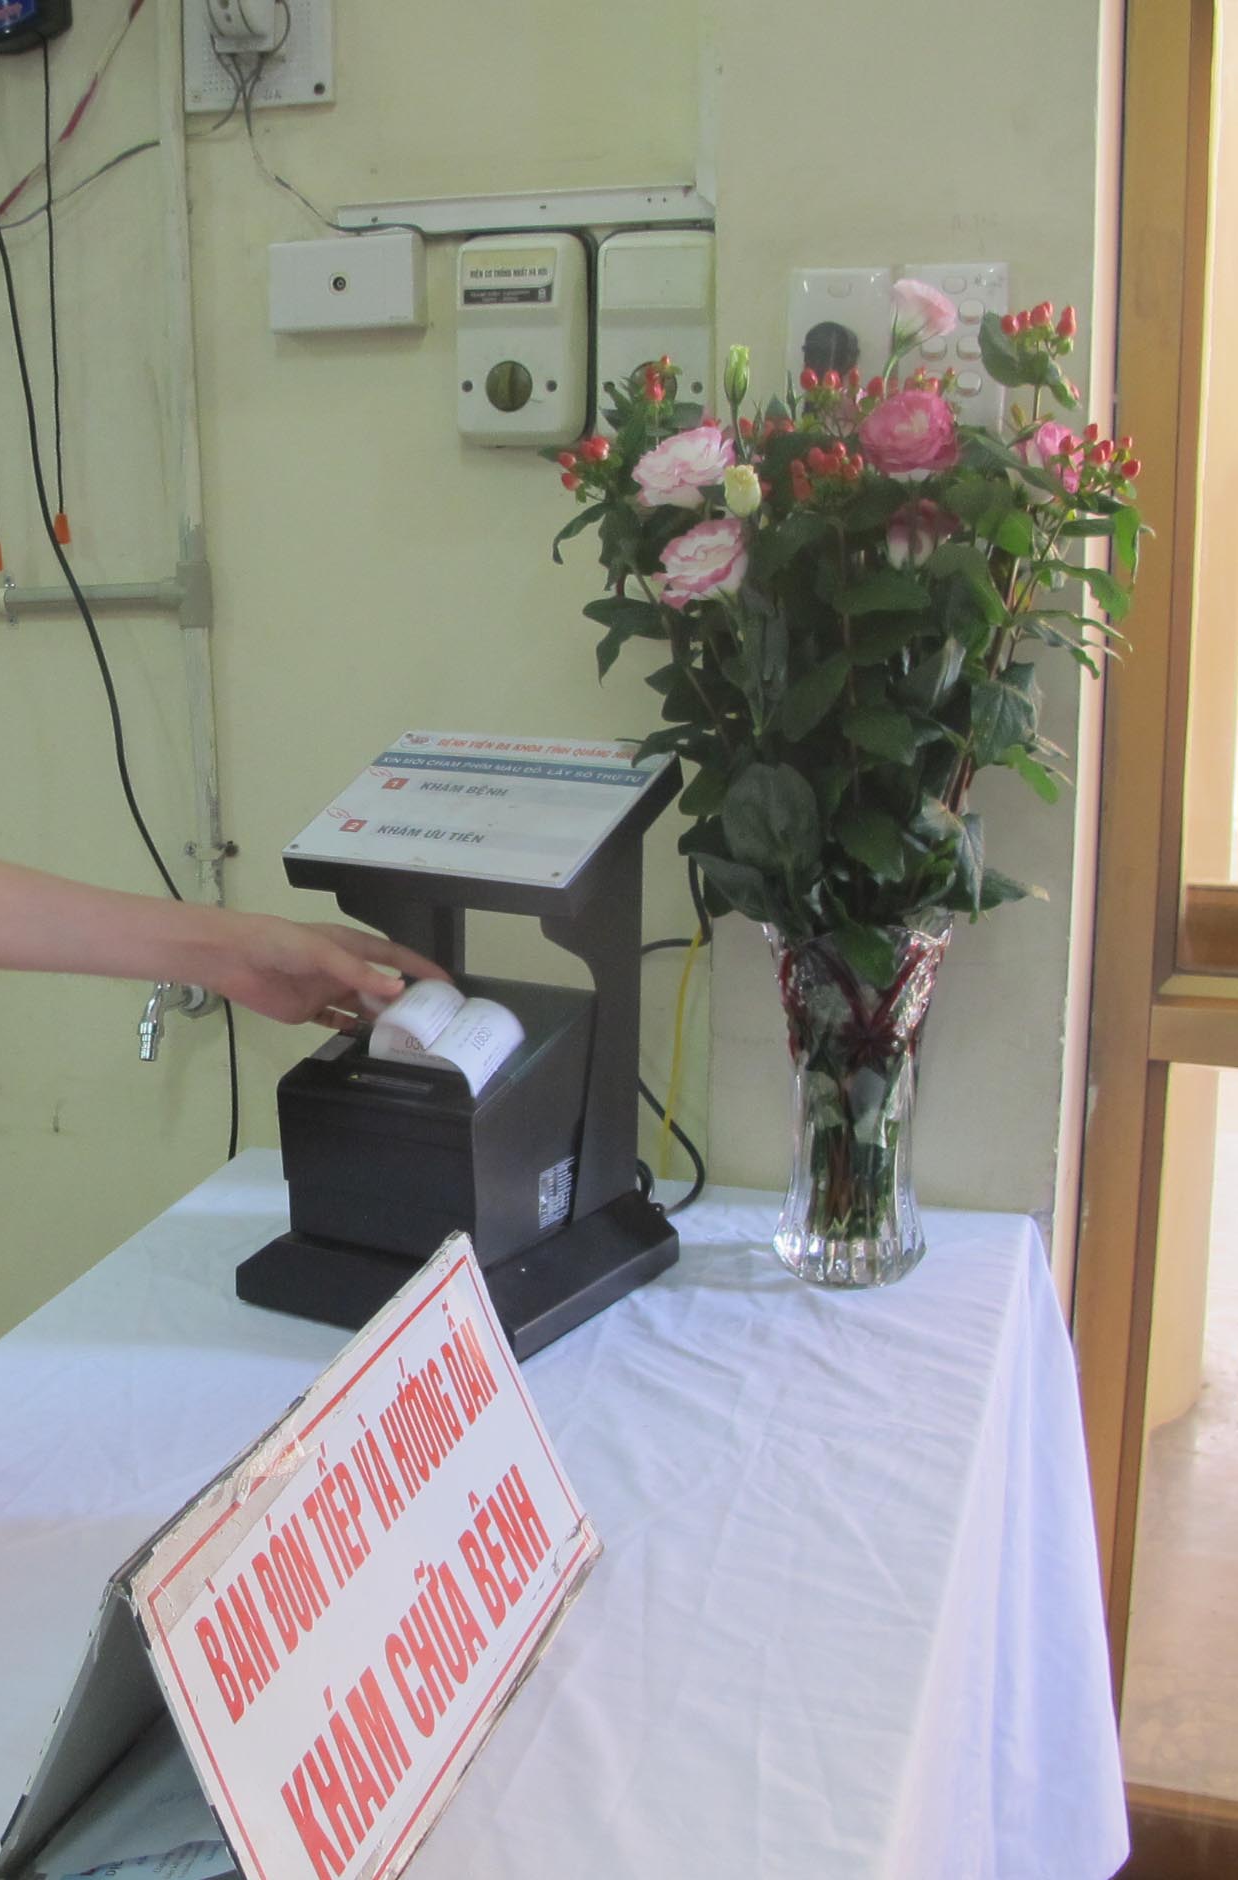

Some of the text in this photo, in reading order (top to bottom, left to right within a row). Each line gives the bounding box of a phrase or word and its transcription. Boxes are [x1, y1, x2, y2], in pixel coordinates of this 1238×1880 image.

[377, 825, 423, 839] KHÁM
[424, 828, 448, 840] ƯU
[449, 831, 485, 844] TIÊN
[420, 781, 463, 793] KHÁM
[466, 784, 509, 797] BỆNH
[194, 1299, 499, 1725] BÀN ĐÓN TIẾP VÀ HƯỚNG DẪN
[280, 1666, 413, 1880] KHÁM
[384, 1560, 489, 1738] CHỮA
